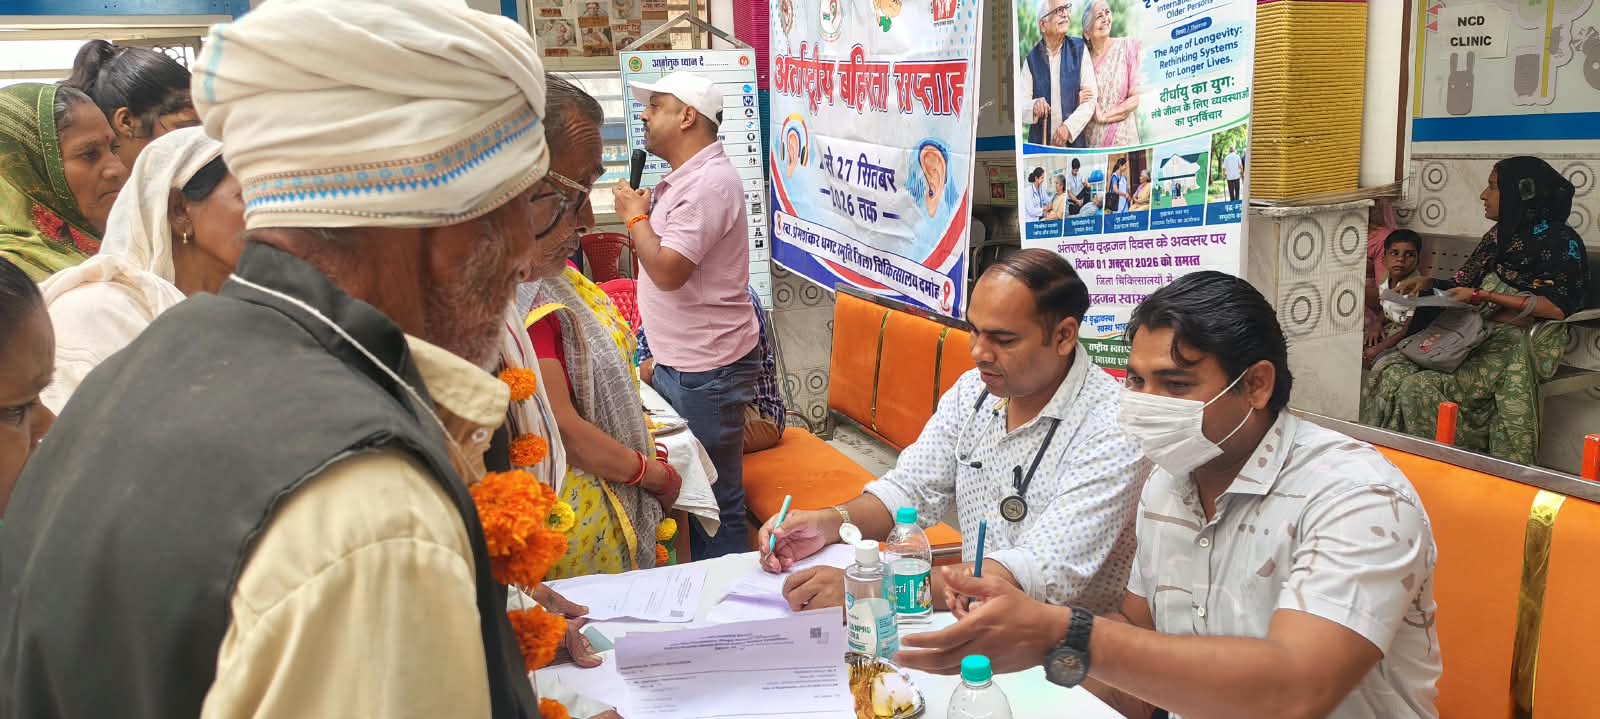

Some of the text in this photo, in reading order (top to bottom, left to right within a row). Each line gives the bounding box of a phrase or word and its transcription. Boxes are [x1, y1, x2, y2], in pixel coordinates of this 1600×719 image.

[1166, 0, 1213, 19] Older Persons
[1457, 16, 1485, 27] NCD
[1153, 49, 1168, 59] The
[1169, 43, 1183, 55] Age
[1184, 38, 1193, 49] of
[1194, 26, 1242, 46] Longevity:
[1450, 36, 1492, 46] CLINIC
[1160, 41, 1238, 69] Rethinking Systems
[1165, 55, 1233, 79] for Longer Lives.
[893, 58, 969, 120] सप्ताह
[1160, 76, 1235, 102] दीर्घायु का युग:
[1163, 104, 1181, 116] जीवन
[1183, 101, 1191, 111] के
[1193, 98, 1209, 109] लिए
[1174, 110, 1223, 127] का पुनर्विचार
[837, 156, 853, 182] 27
[857, 153, 897, 193] सितंबर
[857, 197, 877, 223] तक
[1096, 240, 1126, 254] वृद्धजन
[1128, 236, 1153, 250] दिवस
[1156, 233, 1168, 248] के
[1170, 235, 1207, 247] अवसर
[1210, 233, 1227, 245] पर
[853, 247, 872, 271] जिला
[873, 255, 918, 290] चिकित्सालय
[1075, 257, 1095, 270] दिनांक
[1096, 259, 1106, 270] 01
[1135, 257, 1158, 268] 2026
[1160, 253, 1172, 266] को
[1175, 255, 1200, 266] समस्त
[1096, 276, 1113, 286] जिला
[1115, 322, 1130, 331] भार
[1089, 342, 1109, 353] राष्ट्रीय
